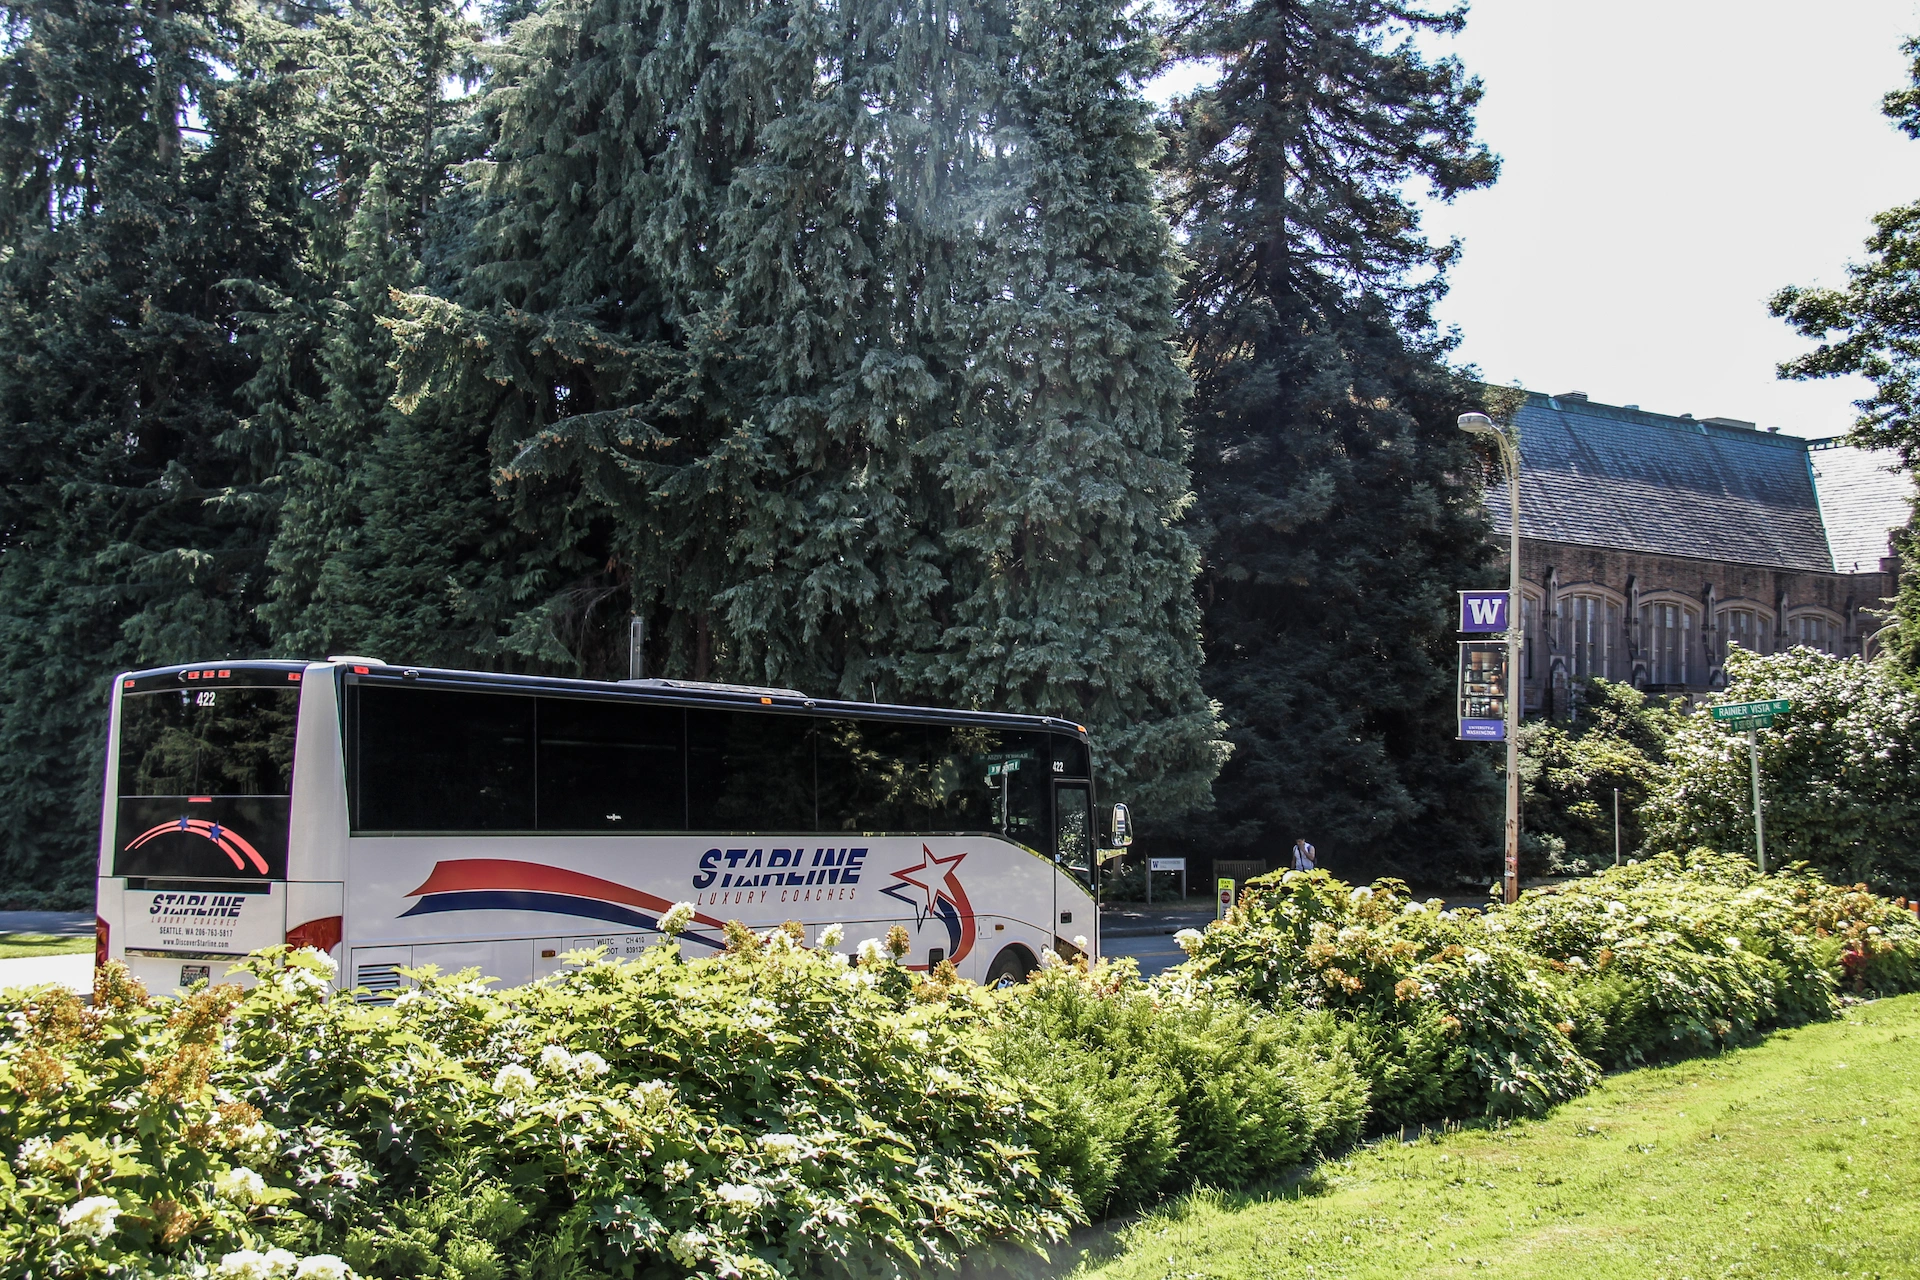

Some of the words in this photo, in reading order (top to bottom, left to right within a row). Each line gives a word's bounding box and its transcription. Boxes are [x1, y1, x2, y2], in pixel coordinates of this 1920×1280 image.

[1467, 598, 1502, 625] W
[196, 692, 216, 707] 422
[1719, 705, 1748, 716] RAINIER
[1750, 703, 1771, 713] VISTA
[1052, 761, 1064, 772] 422
[692, 848, 869, 889] STARLINE
[1152, 860, 1159, 869] W
[697, 890, 768, 907] LUXURY
[781, 887, 857, 903] COACHES
[149, 893, 246, 918] STARLINE
[151, 916, 187, 925] LUXURY
[193, 917, 238, 927] COACHES
[159, 926, 184, 936] SEATTLE,
[185, 927, 194, 936] WA
[195, 928, 233, 938] 206-763-5817
[163, 938, 229, 948] www.DiscoverStarline.com
[596, 937, 615, 945] WUTC
